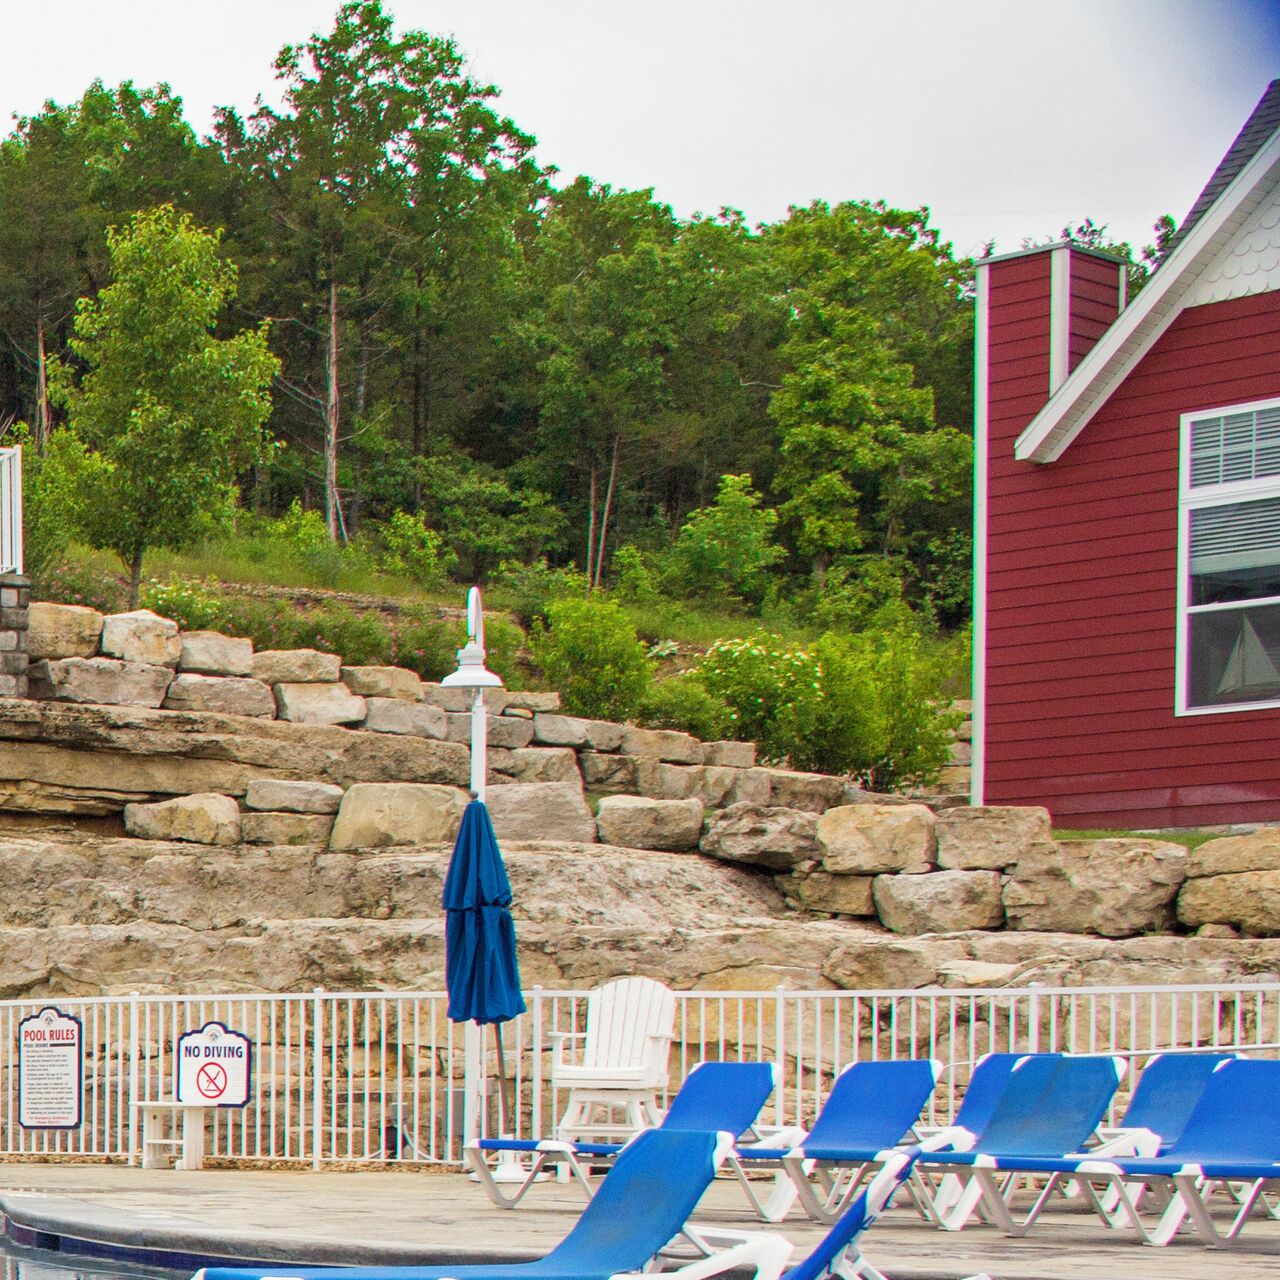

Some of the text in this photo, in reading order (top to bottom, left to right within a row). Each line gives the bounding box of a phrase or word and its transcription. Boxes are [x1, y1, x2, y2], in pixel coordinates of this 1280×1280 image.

[24, 1029, 75, 1041] POOL RULES
[184, 1046, 243, 1058] NO DIVING
